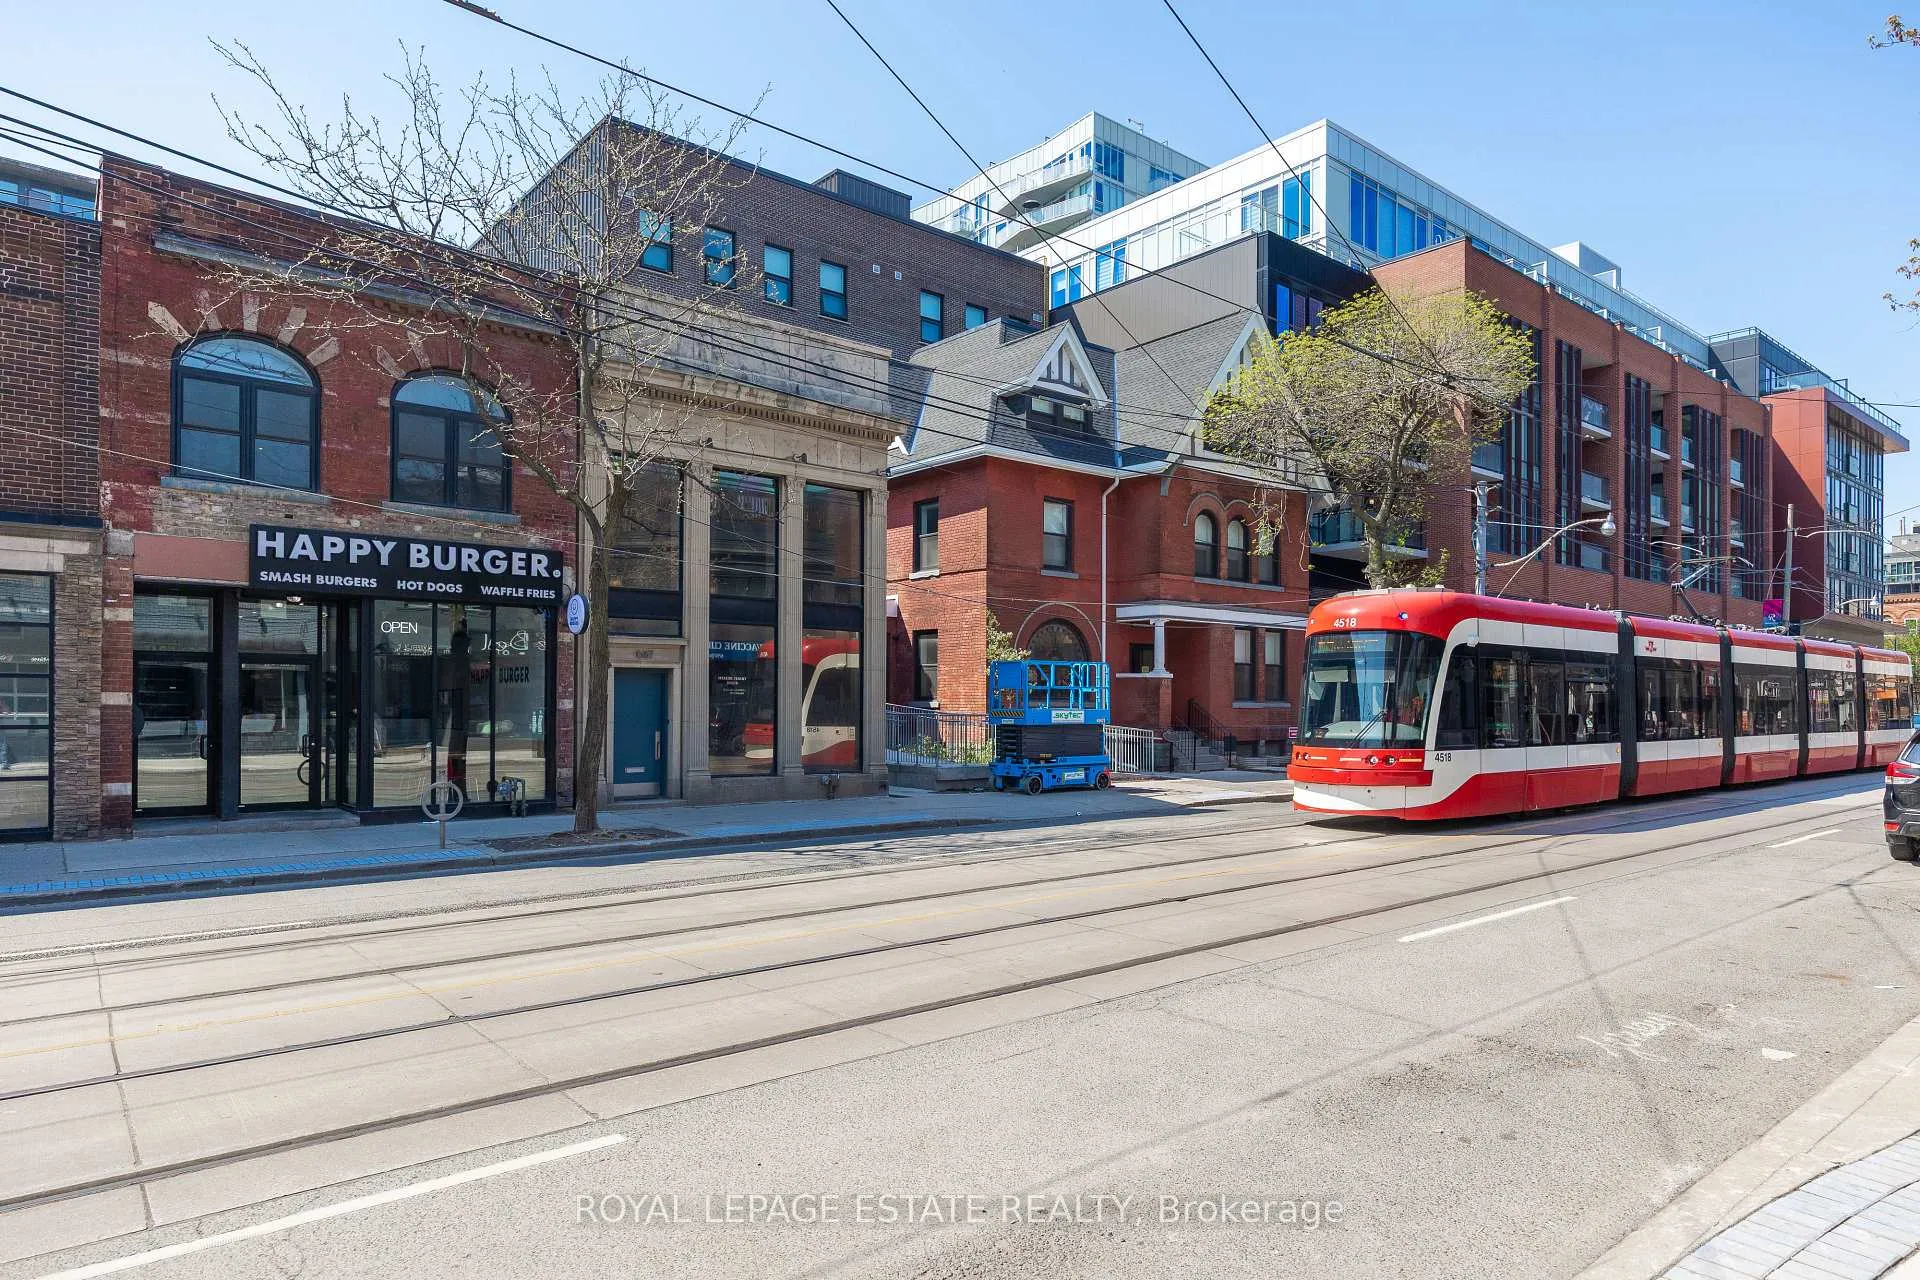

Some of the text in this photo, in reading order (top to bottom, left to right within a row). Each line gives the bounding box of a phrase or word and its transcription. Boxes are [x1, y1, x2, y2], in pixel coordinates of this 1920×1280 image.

[257, 530, 397, 566] HAPPY
[259, 571, 377, 588] SMASH BURGERS
[396, 580, 463, 594] HOT DOGS
[480, 585, 556, 599] WAFFLE FRIES
[380, 620, 418, 634] OPEN
[1333, 618, 1357, 628] 4518
[471, 665, 530, 684] HAPP BURGER
[1434, 752, 1452, 762] 4518
